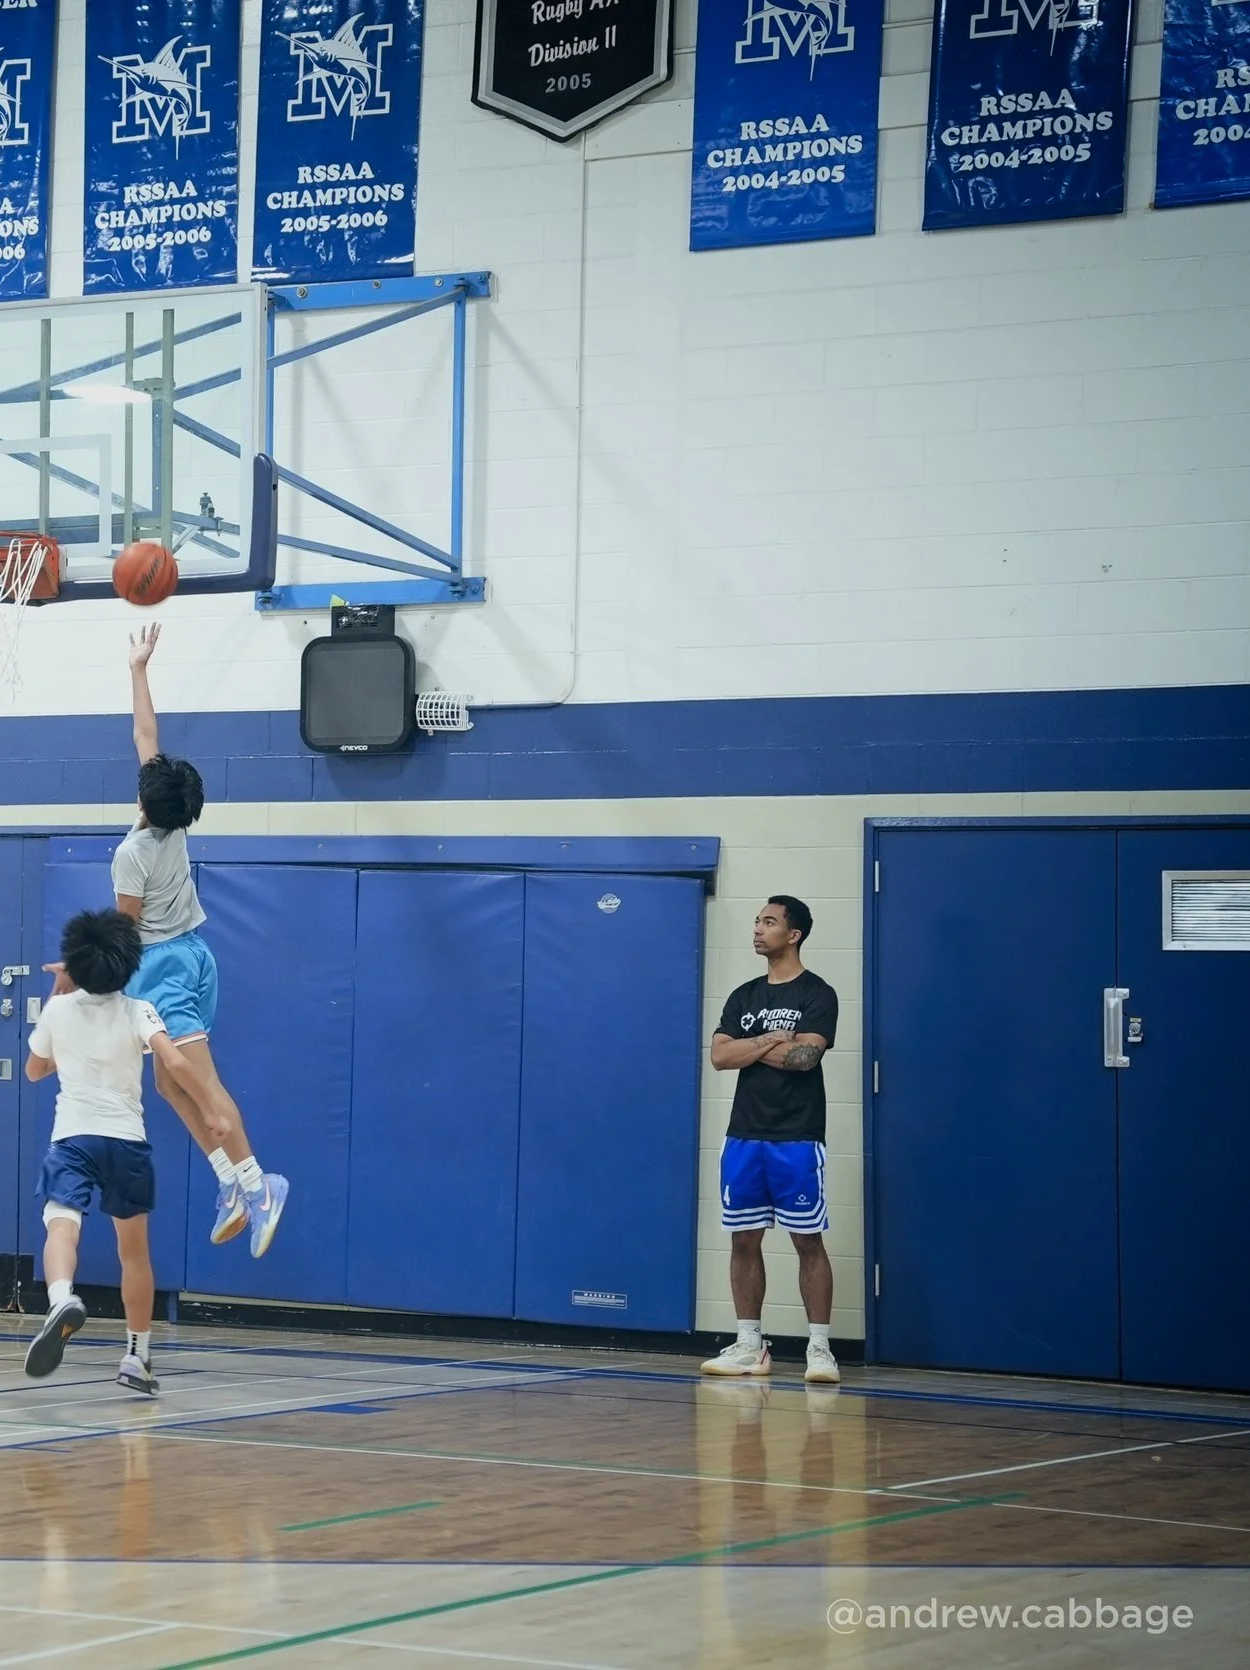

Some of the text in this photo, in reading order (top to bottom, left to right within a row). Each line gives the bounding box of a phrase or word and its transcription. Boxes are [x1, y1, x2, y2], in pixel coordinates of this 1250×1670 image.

[531, 0, 582, 25] Rugby
[528, 36, 600, 67] Division
[545, 73, 592, 93] 2005
[979, 88, 1077, 117] RSSAA
[740, 113, 830, 141] RSSAA
[941, 111, 1113, 146] CHAMPIONS
[707, 134, 863, 169] CHAMPIONS
[959, 143, 1091, 171] 2004-2005
[296, 162, 375, 185] RSSAA
[722, 164, 845, 192] 2004-2005
[122, 180, 198, 204] RSSAA
[266, 184, 405, 210] CHAMPIONS
[95, 202, 227, 229] CHAMPIONS
[280, 210, 388, 235] 2005-2006
[108, 226, 213, 252] 2005-2006
